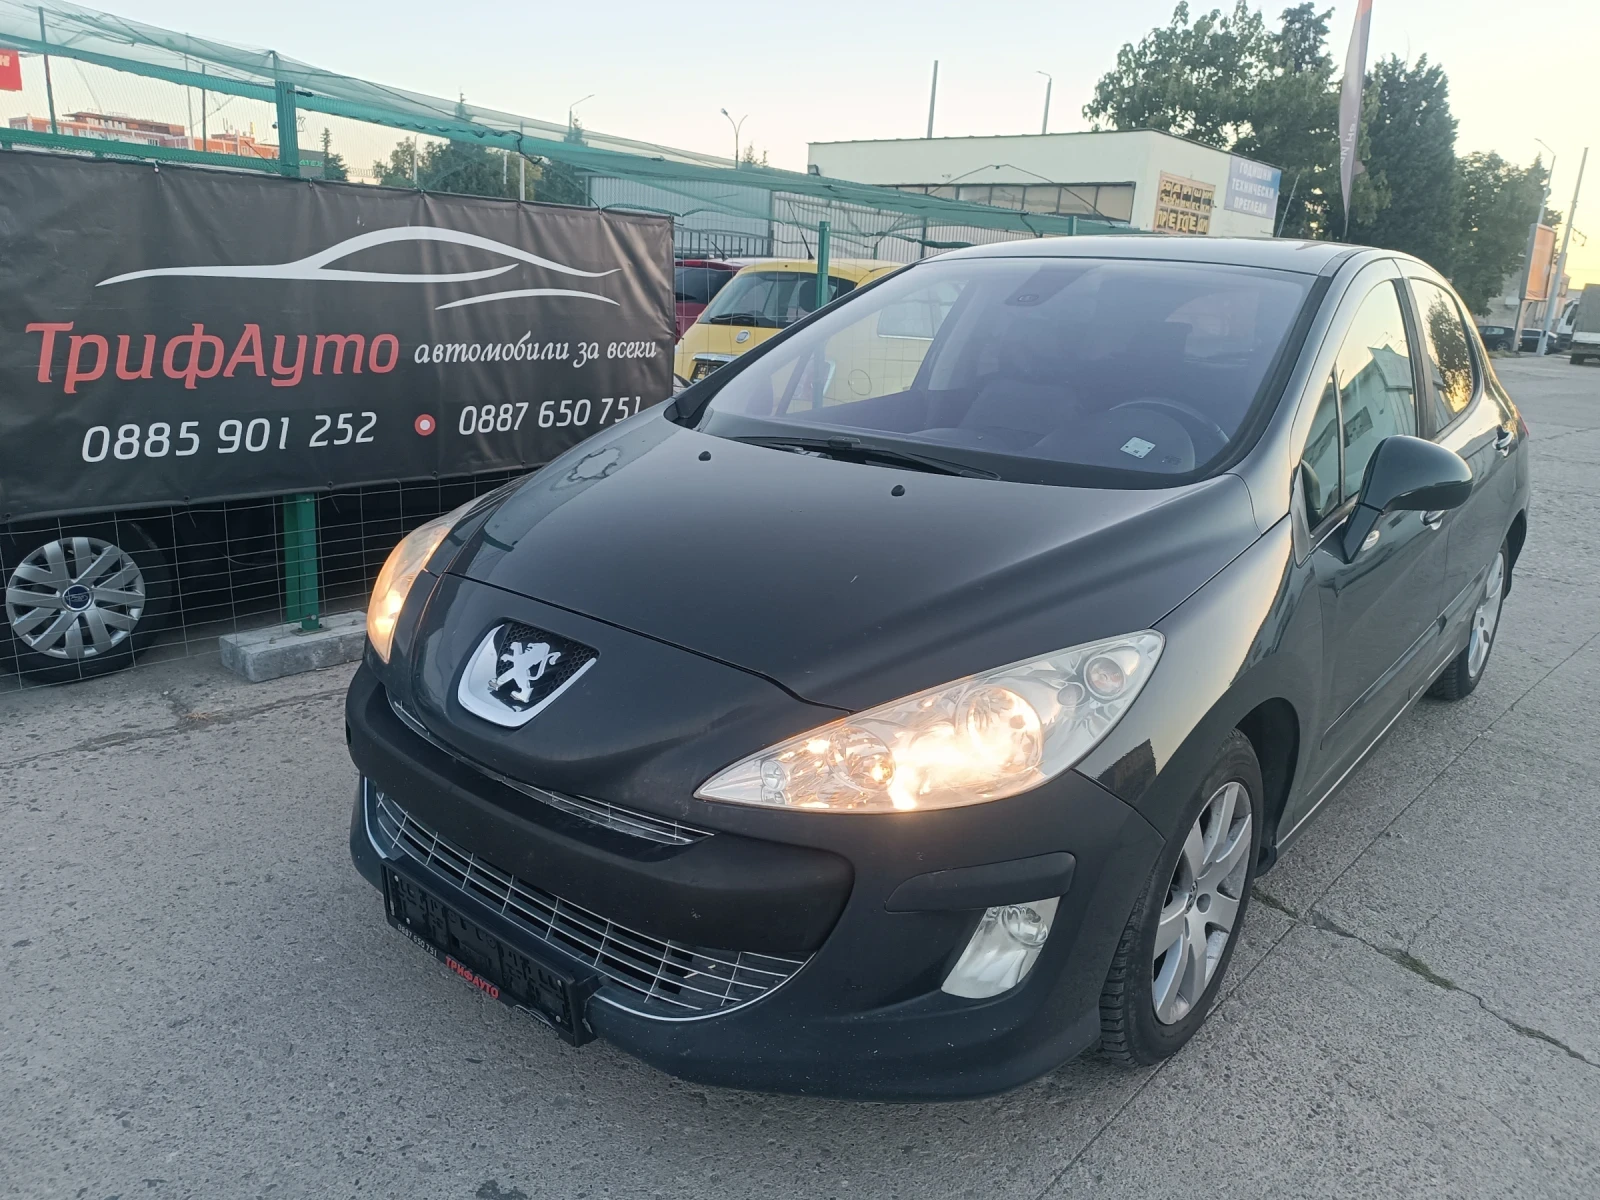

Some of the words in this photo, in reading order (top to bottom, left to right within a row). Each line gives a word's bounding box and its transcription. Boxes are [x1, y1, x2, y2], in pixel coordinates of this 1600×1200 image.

[1231, 177, 1274, 199] ТЕХНИЧЕСКИ
[1239, 161, 1272, 181] ГОДИШНИ
[1233, 195, 1267, 215] ПРЕГЛЕДИ
[25, 321, 399, 394] ТрифАуто
[414, 330, 569, 363] автомобили
[572, 341, 600, 369] за
[606, 340, 657, 359] всеки
[458, 402, 529, 436] 0887
[537, 398, 591, 428] 650
[599, 395, 641, 425] 751
[82, 421, 200, 462] 0885
[217, 417, 289, 454] 901
[308, 411, 377, 447] 252
[397, 923, 412, 938] 0887
[413, 935, 425, 948] 650
[426, 943, 437, 957] 751
[445, 955, 499, 999] ТРИФАУТО
